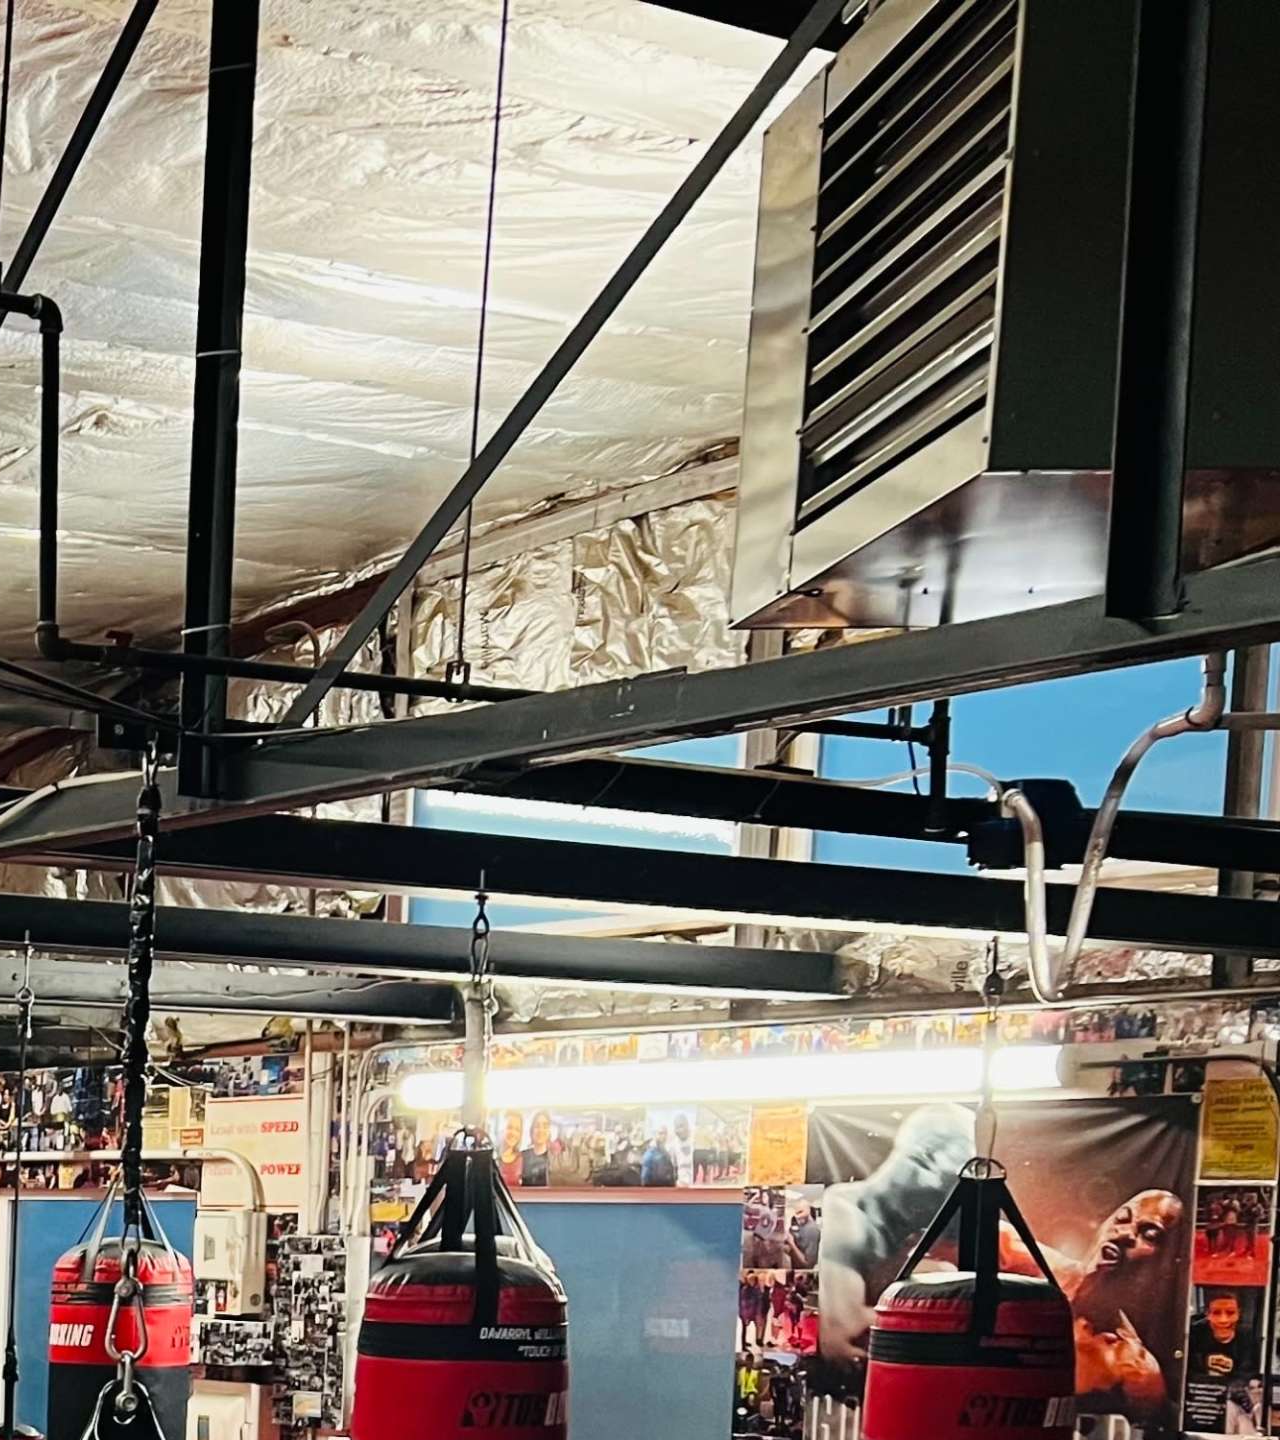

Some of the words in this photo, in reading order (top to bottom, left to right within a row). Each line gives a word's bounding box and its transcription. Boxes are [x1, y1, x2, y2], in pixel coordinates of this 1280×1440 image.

[260, 1121, 299, 1133] SPEED
[260, 1163, 302, 1176] POWER
[480, 1327, 532, 1340] DAVARRYL
